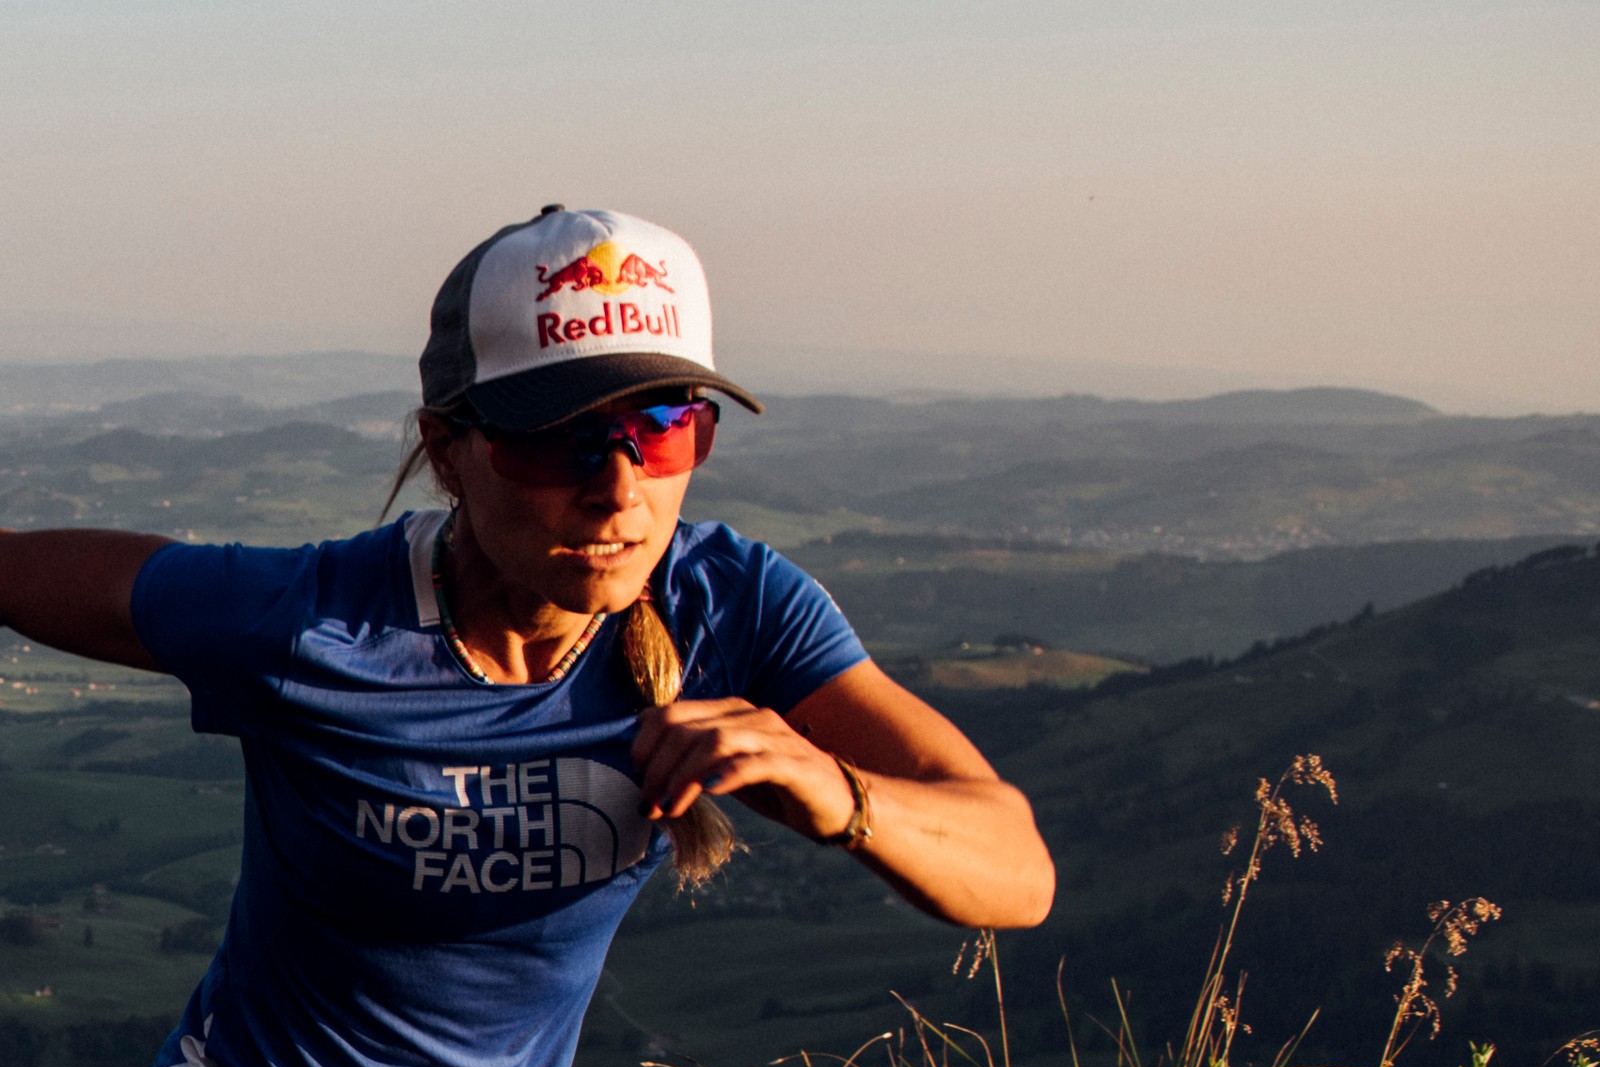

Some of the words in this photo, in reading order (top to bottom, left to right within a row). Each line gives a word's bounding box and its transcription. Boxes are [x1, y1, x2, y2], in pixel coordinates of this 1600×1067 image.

[537, 302, 614, 348] Red
[619, 302, 680, 337] Bull
[442, 759, 552, 807] THE
[357, 800, 554, 849] NORTH
[413, 850, 553, 894] FACE
